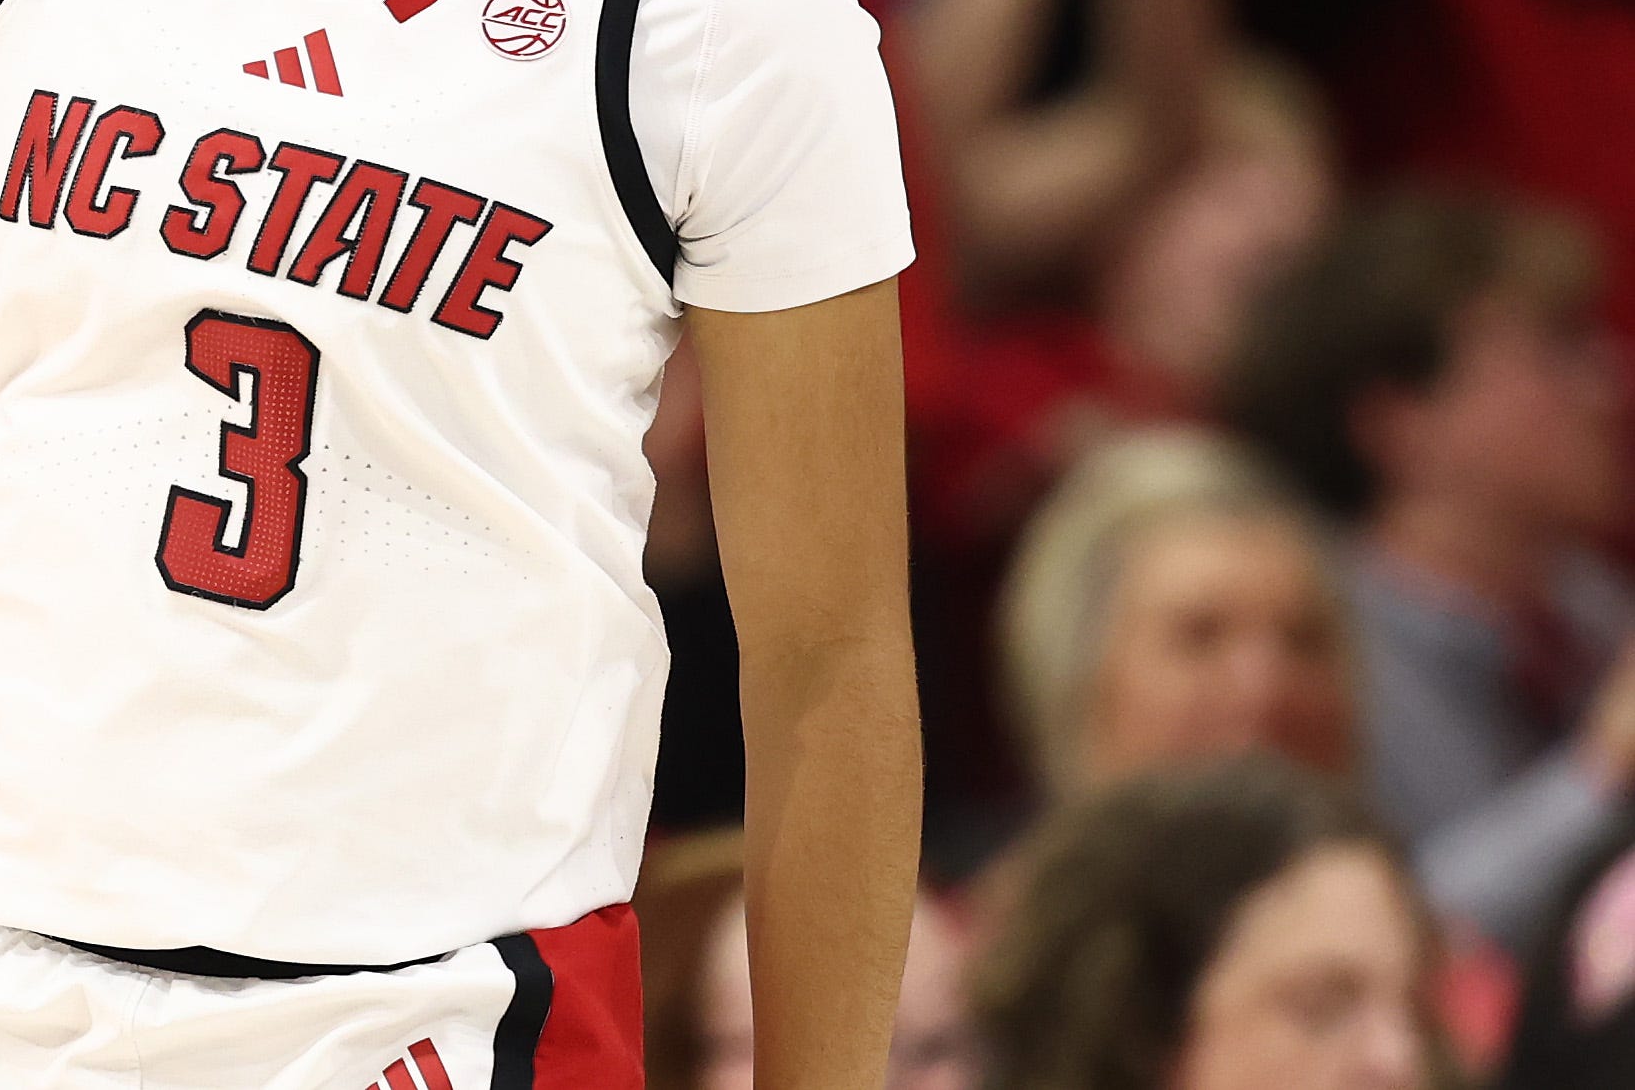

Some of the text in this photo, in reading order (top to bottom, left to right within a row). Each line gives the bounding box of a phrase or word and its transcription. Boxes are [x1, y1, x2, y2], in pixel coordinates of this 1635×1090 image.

[492, 6, 566, 29] ACC
[0, 89, 553, 340] NC STATE
[155, 309, 321, 610] 3
